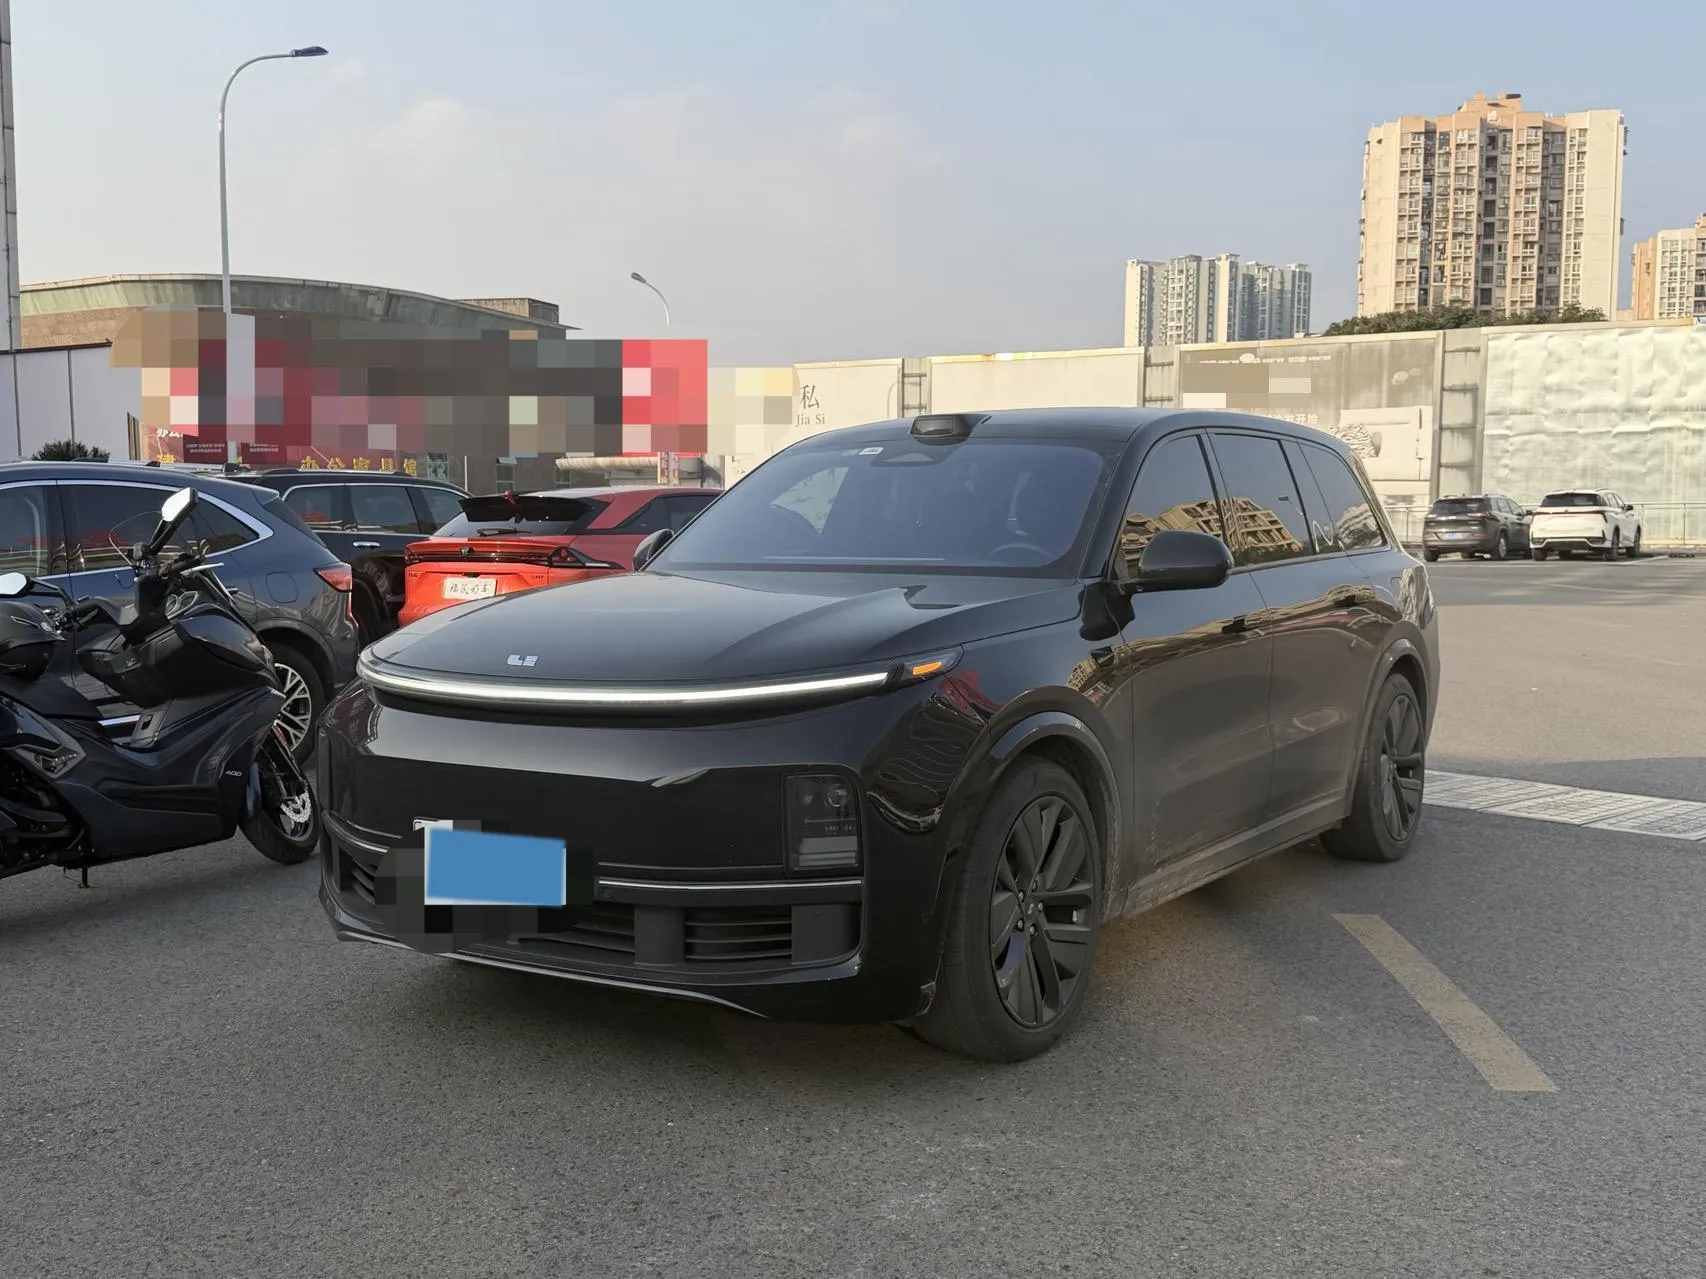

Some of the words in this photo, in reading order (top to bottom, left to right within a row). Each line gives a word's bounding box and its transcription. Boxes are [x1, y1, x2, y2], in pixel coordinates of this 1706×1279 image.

[800, 384, 820, 410] 私
[795, 413, 810, 428] Jia
[815, 413, 825, 425] Si
